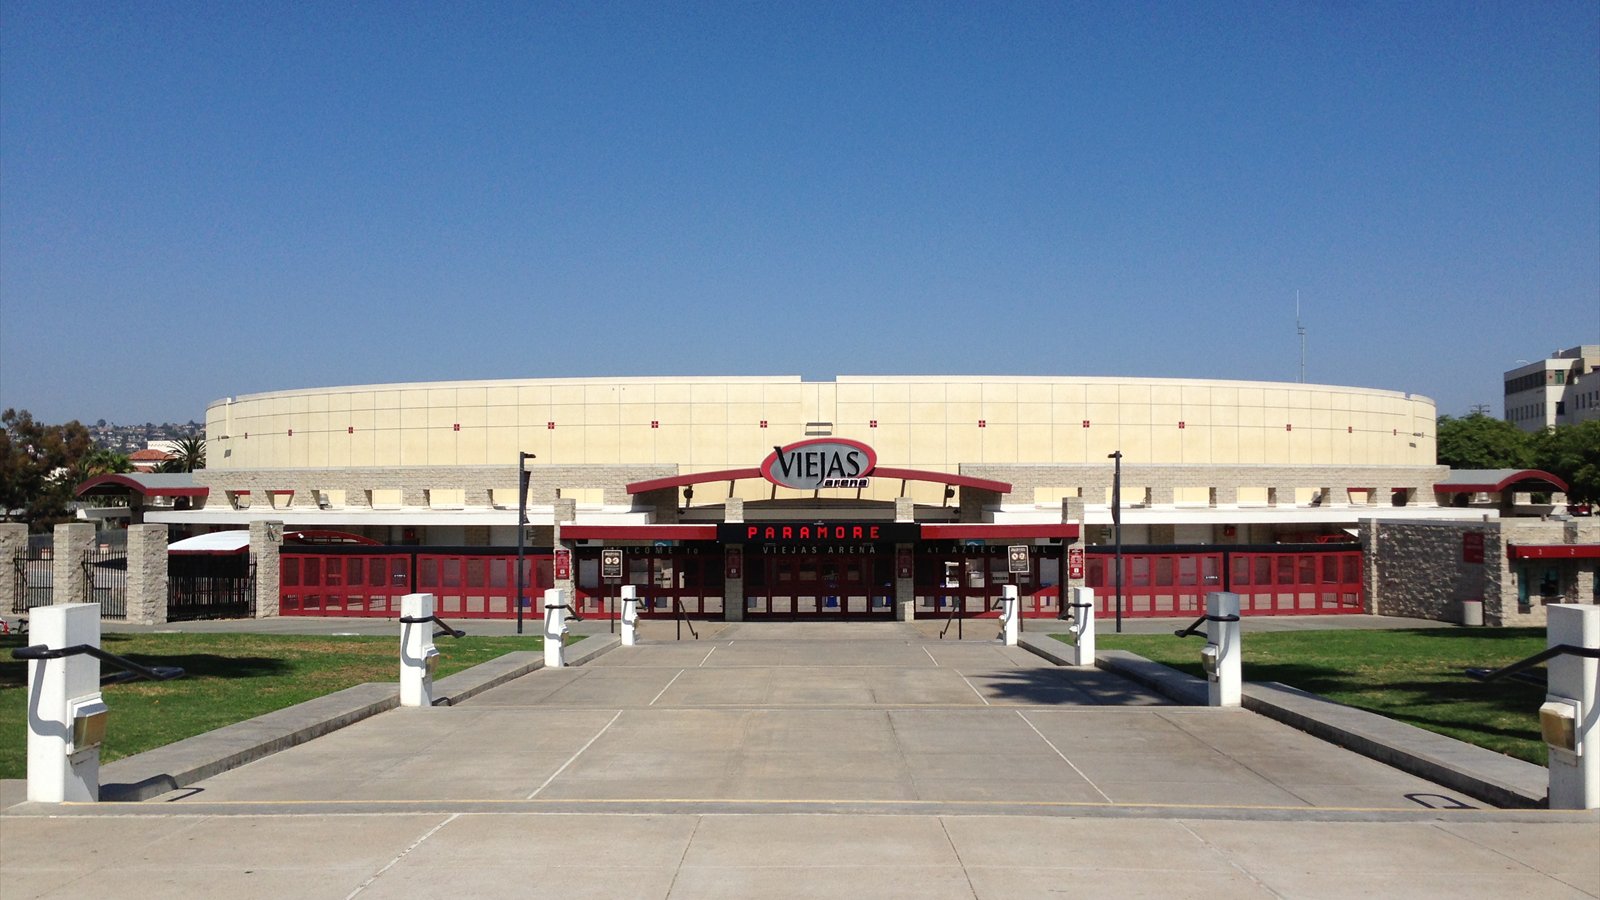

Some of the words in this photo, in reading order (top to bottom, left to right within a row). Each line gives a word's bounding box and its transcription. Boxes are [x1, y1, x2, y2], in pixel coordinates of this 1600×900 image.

[773, 446, 860, 486] VIEJAS
[823, 478, 868, 488] arena
[747, 526, 880, 539] PARAMORE
[762, 546, 818, 554] VIEJAS
[827, 546, 877, 554] ARENA
[951, 546, 996, 554] AZTEC
